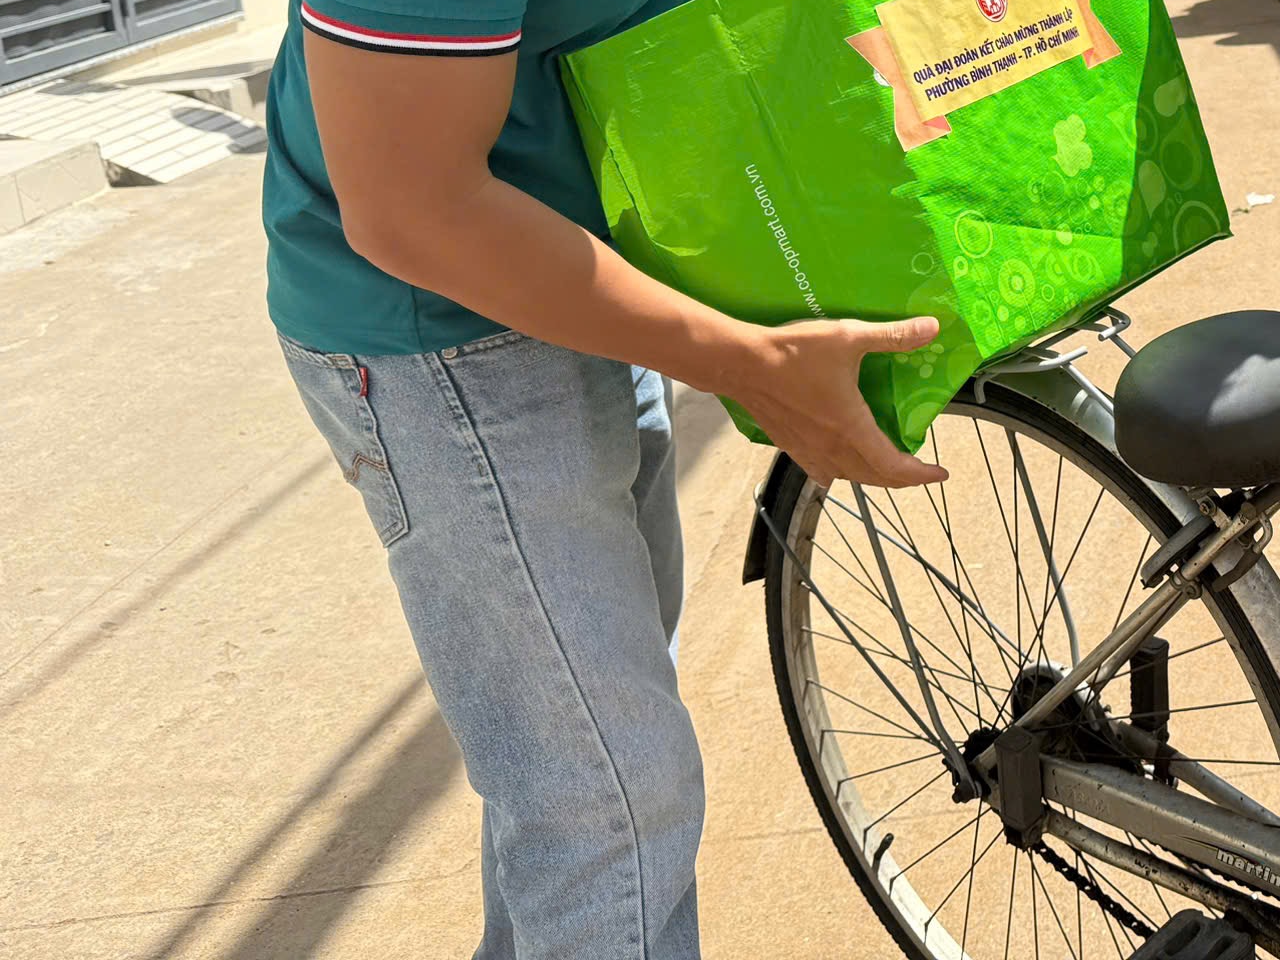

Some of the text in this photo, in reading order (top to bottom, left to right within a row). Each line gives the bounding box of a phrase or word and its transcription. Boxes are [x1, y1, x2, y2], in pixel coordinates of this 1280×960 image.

[913, 63, 936, 85] QUÀ
[934, 58, 954, 75] ĐẠI
[953, 48, 979, 68] ĐOÀN
[978, 38, 996, 57] KẾT
[995, 32, 1015, 50] CHÀO
[1013, 25, 1039, 42] MỪNG
[1038, 12, 1064, 32] THÀNH
[925, 74, 970, 101] PHƯỜNG
[969, 64, 993, 83] BÌNH
[992, 52, 1018, 73] THẠNH
[1022, 45, 1036, 60] TP.
[1034, 36, 1048, 54] HỒ
[1047, 29, 1063, 48] CHÍ
[1061, 26, 1080, 43] MINH
